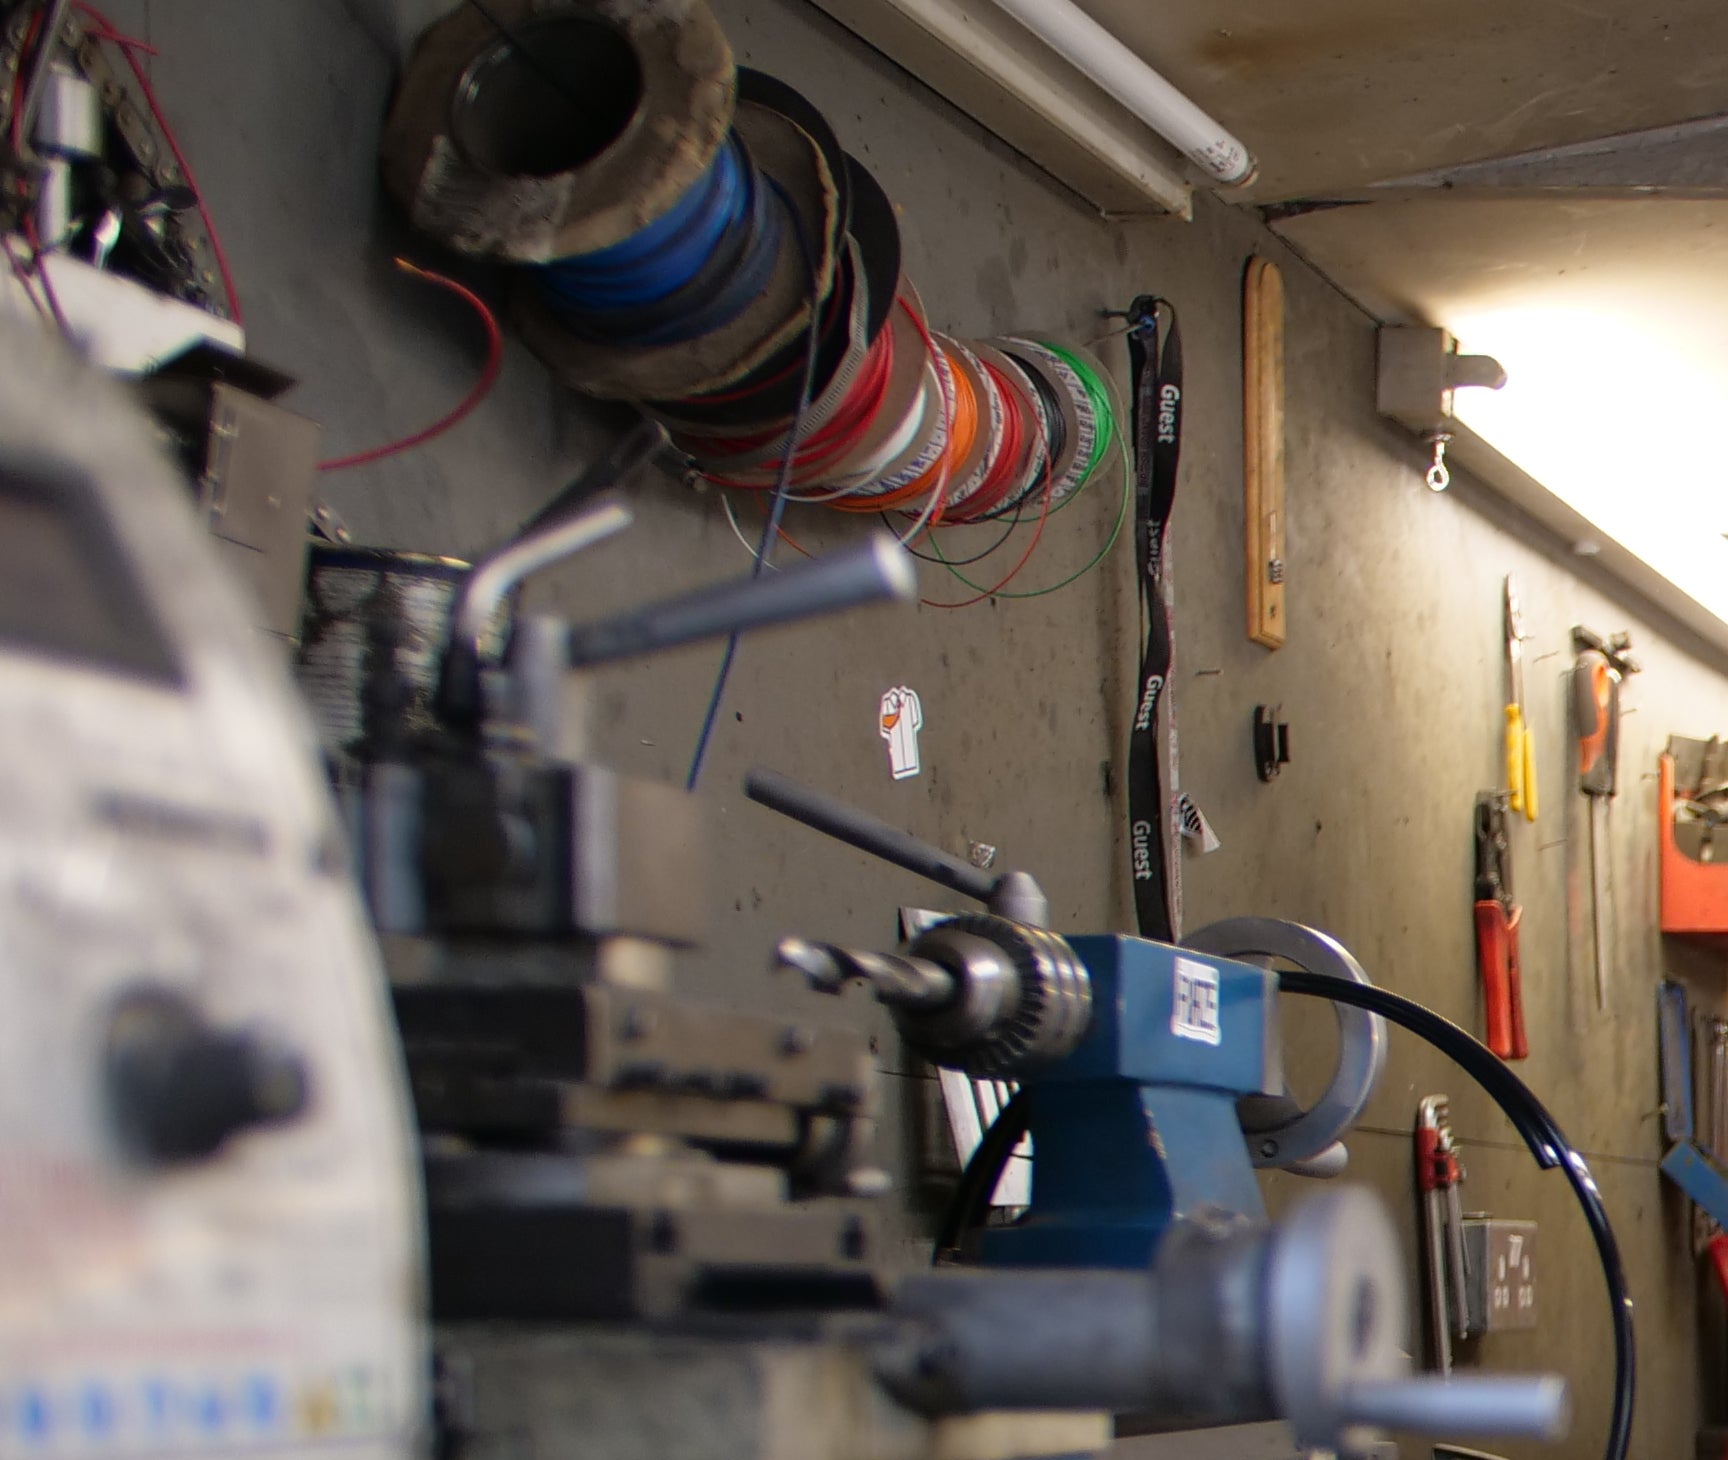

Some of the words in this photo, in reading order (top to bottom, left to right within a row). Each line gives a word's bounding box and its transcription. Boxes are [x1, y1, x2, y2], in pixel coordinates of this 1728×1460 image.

[1157, 384, 1180, 444] Guest
[1135, 674, 1163, 731] Guest
[1132, 820, 1153, 880] Guest
